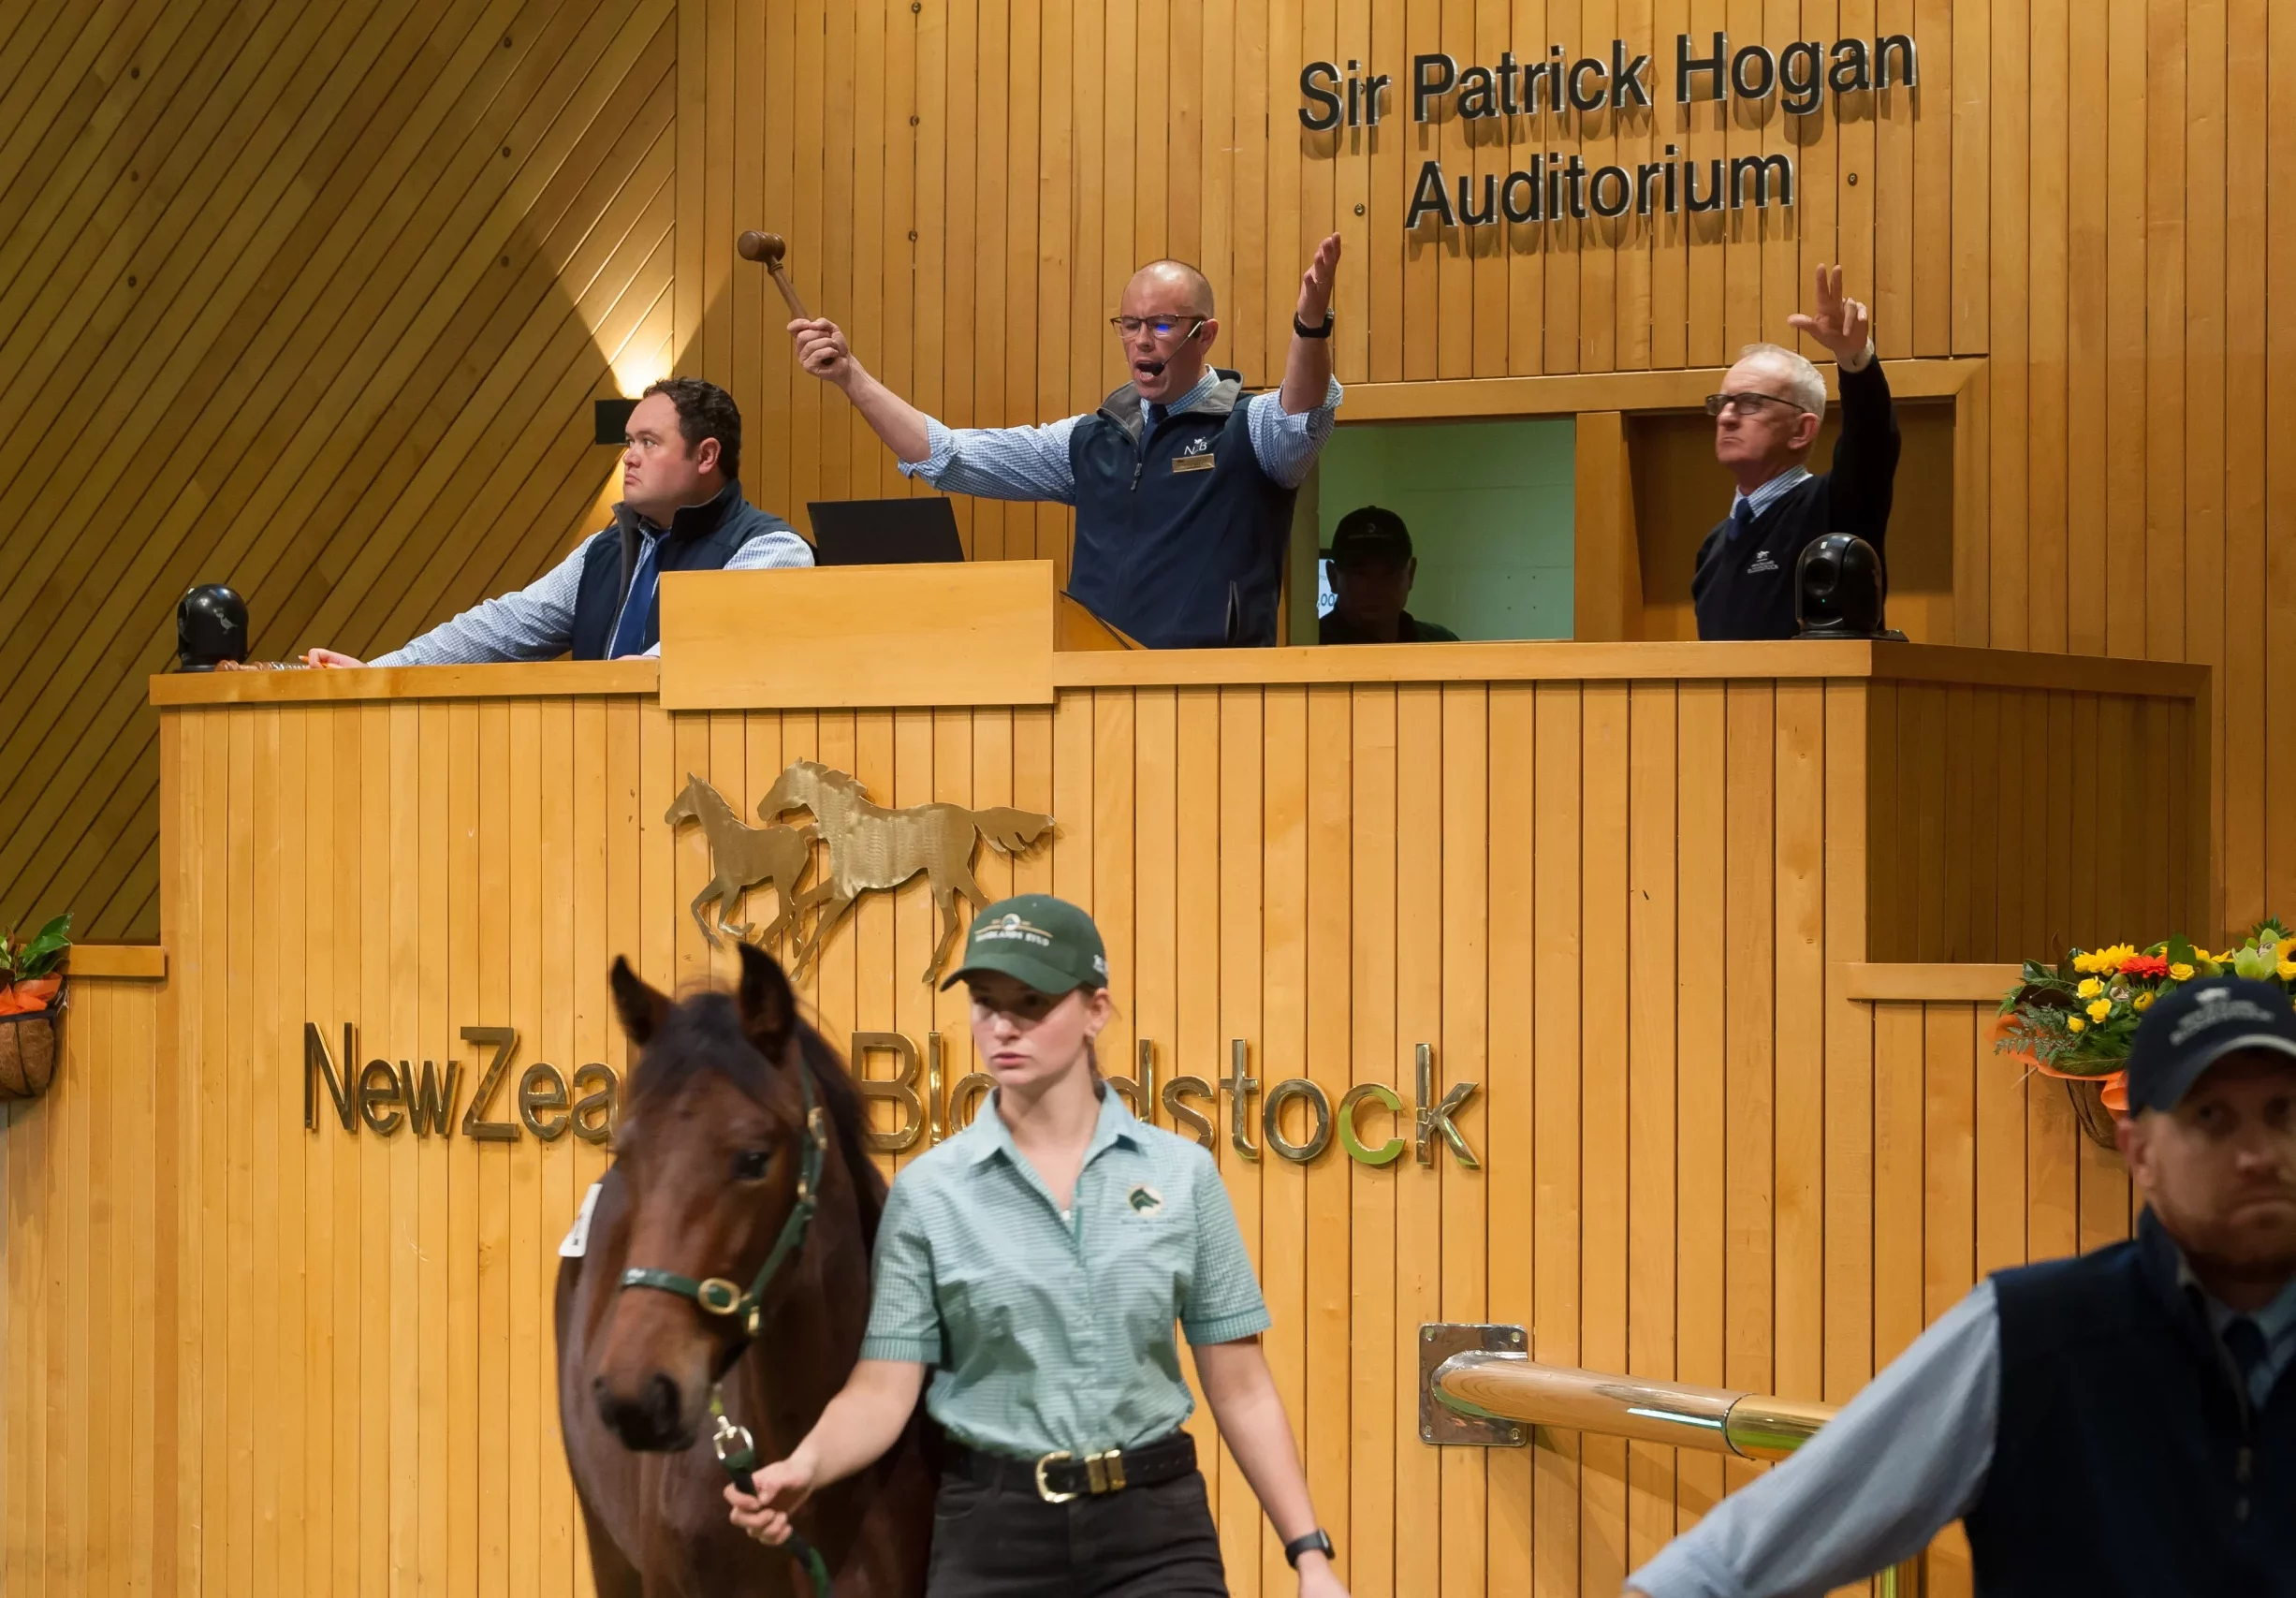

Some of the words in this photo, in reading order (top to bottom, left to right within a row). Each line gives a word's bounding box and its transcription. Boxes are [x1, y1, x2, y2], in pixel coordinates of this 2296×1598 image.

[1297, 59, 1391, 132] Sir
[1413, 38, 1651, 123] Patrick
[1676, 31, 1918, 116] Hogan
[1405, 144, 1794, 229] Auditorium
[304, 1021, 618, 1144] NewZea
